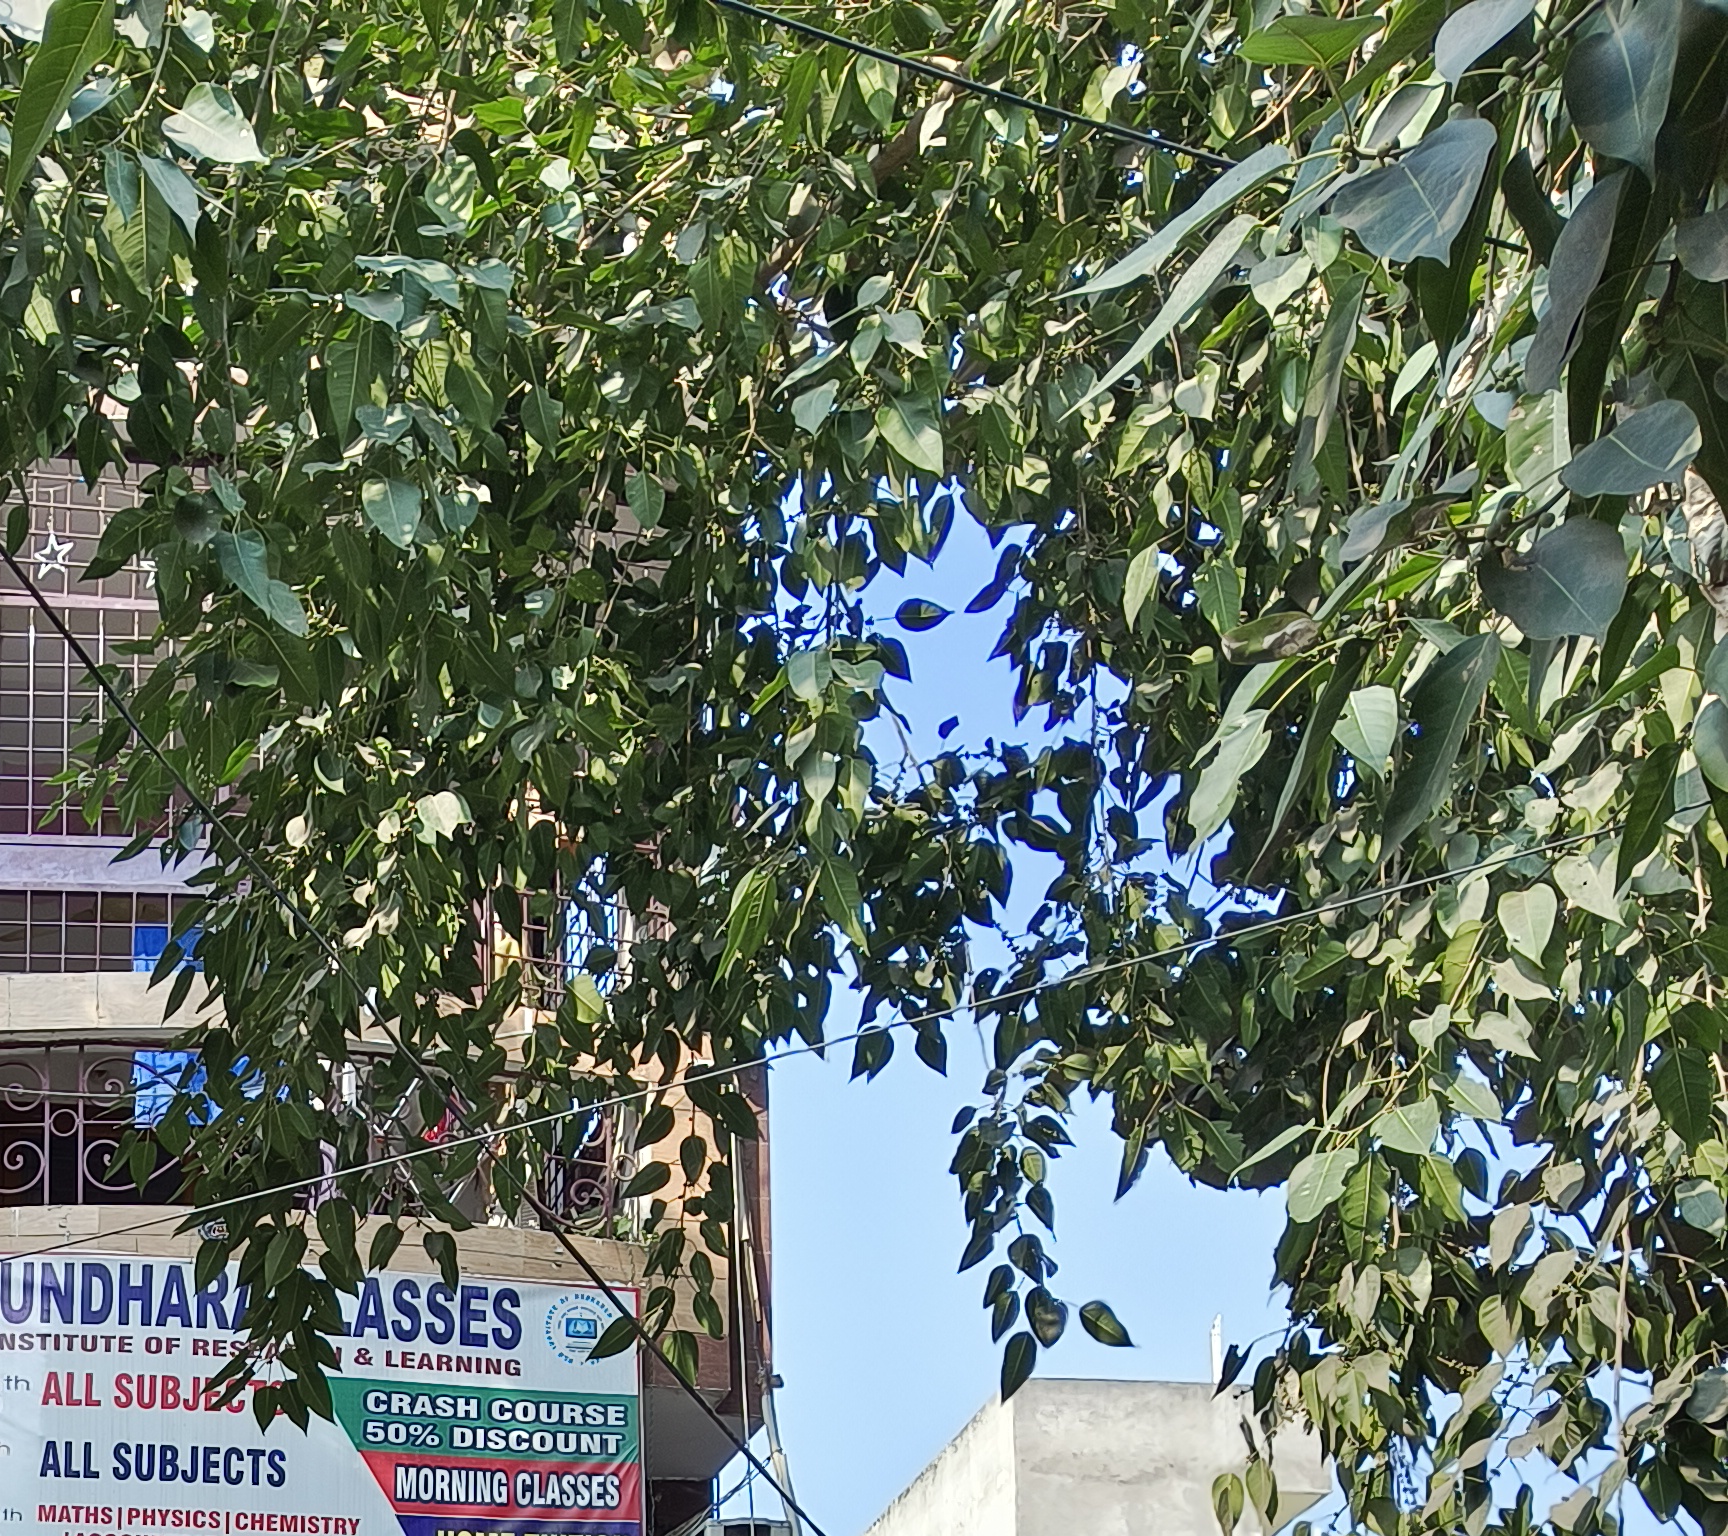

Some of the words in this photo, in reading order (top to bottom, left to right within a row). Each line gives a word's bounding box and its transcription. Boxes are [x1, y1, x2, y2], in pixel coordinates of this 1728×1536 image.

[144, 1336, 180, 1353] OF
[353, 1347, 374, 1366] &
[385, 1351, 522, 1377] LEARNING
[41, 1371, 101, 1407] ALL
[366, 1390, 478, 1420] CRASH
[491, 1399, 627, 1427] COURSE
[366, 1421, 440, 1448] 50%
[453, 1425, 623, 1455] DISCOUNT
[40, 1440, 100, 1479] ALL
[112, 1441, 287, 1487] SUBJECTS
[396, 1465, 508, 1505] MORNING
[516, 1471, 620, 1508] CLASSES
